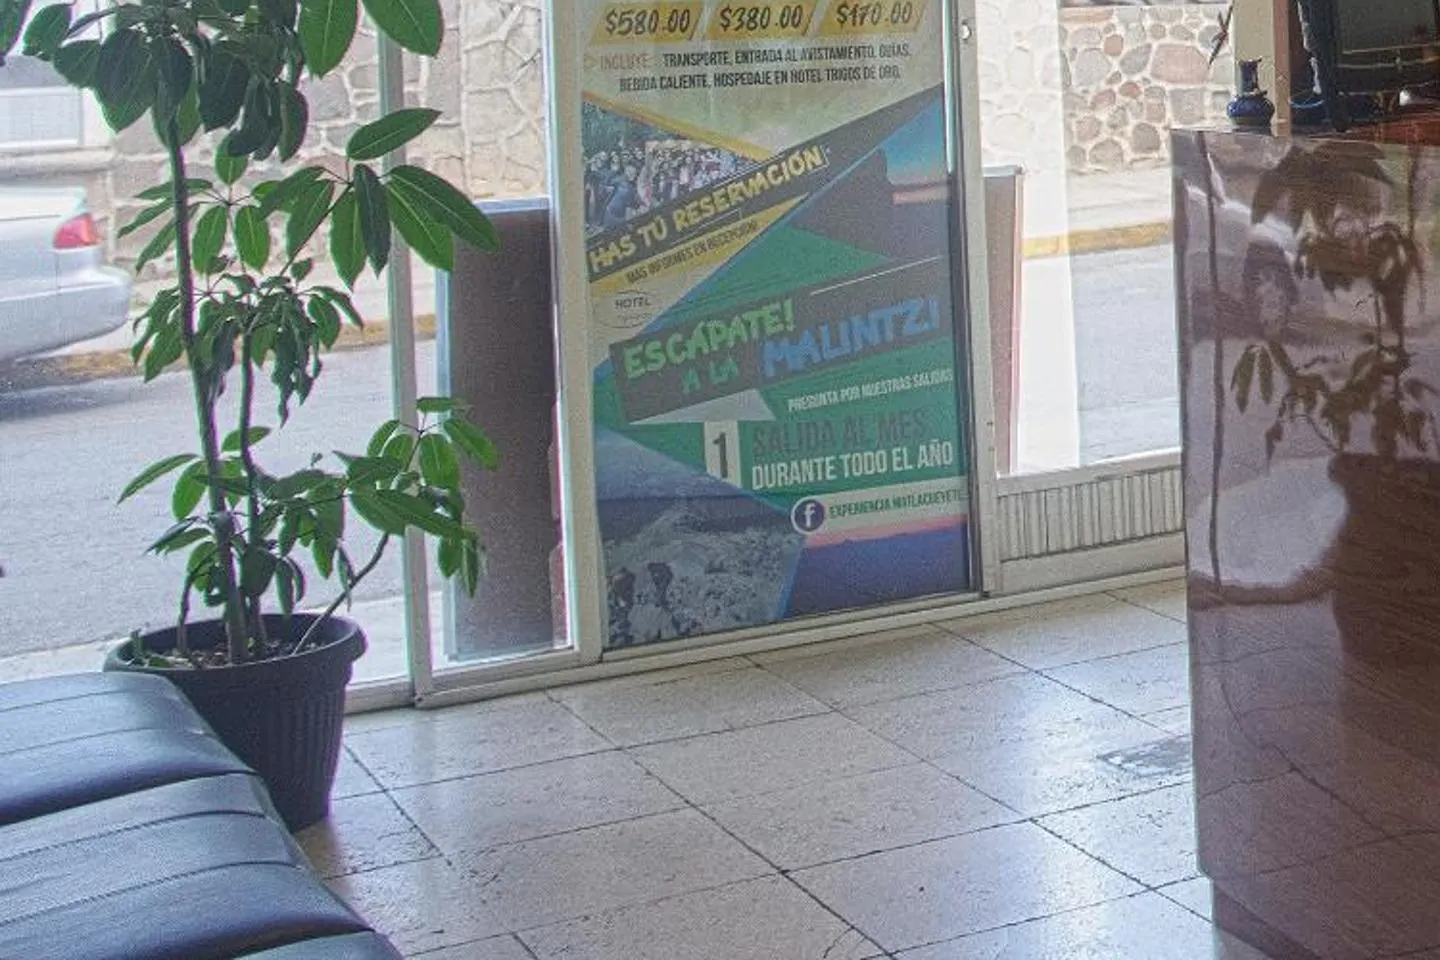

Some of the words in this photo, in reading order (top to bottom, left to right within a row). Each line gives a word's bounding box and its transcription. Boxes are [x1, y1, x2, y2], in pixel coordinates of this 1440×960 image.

[605, 7, 692, 36] $580.00
[719, 4, 804, 31] $380.00
[790, 68, 823, 84] HOTEL
[589, 235, 637, 273] HAS
[672, 144, 824, 233] RESERVACIÓN
[713, 431, 729, 479] 1
[751, 459, 837, 491] DURANTE
[843, 451, 888, 478] TODO
[892, 446, 914, 472] EL
[917, 438, 954, 470] AÑO
